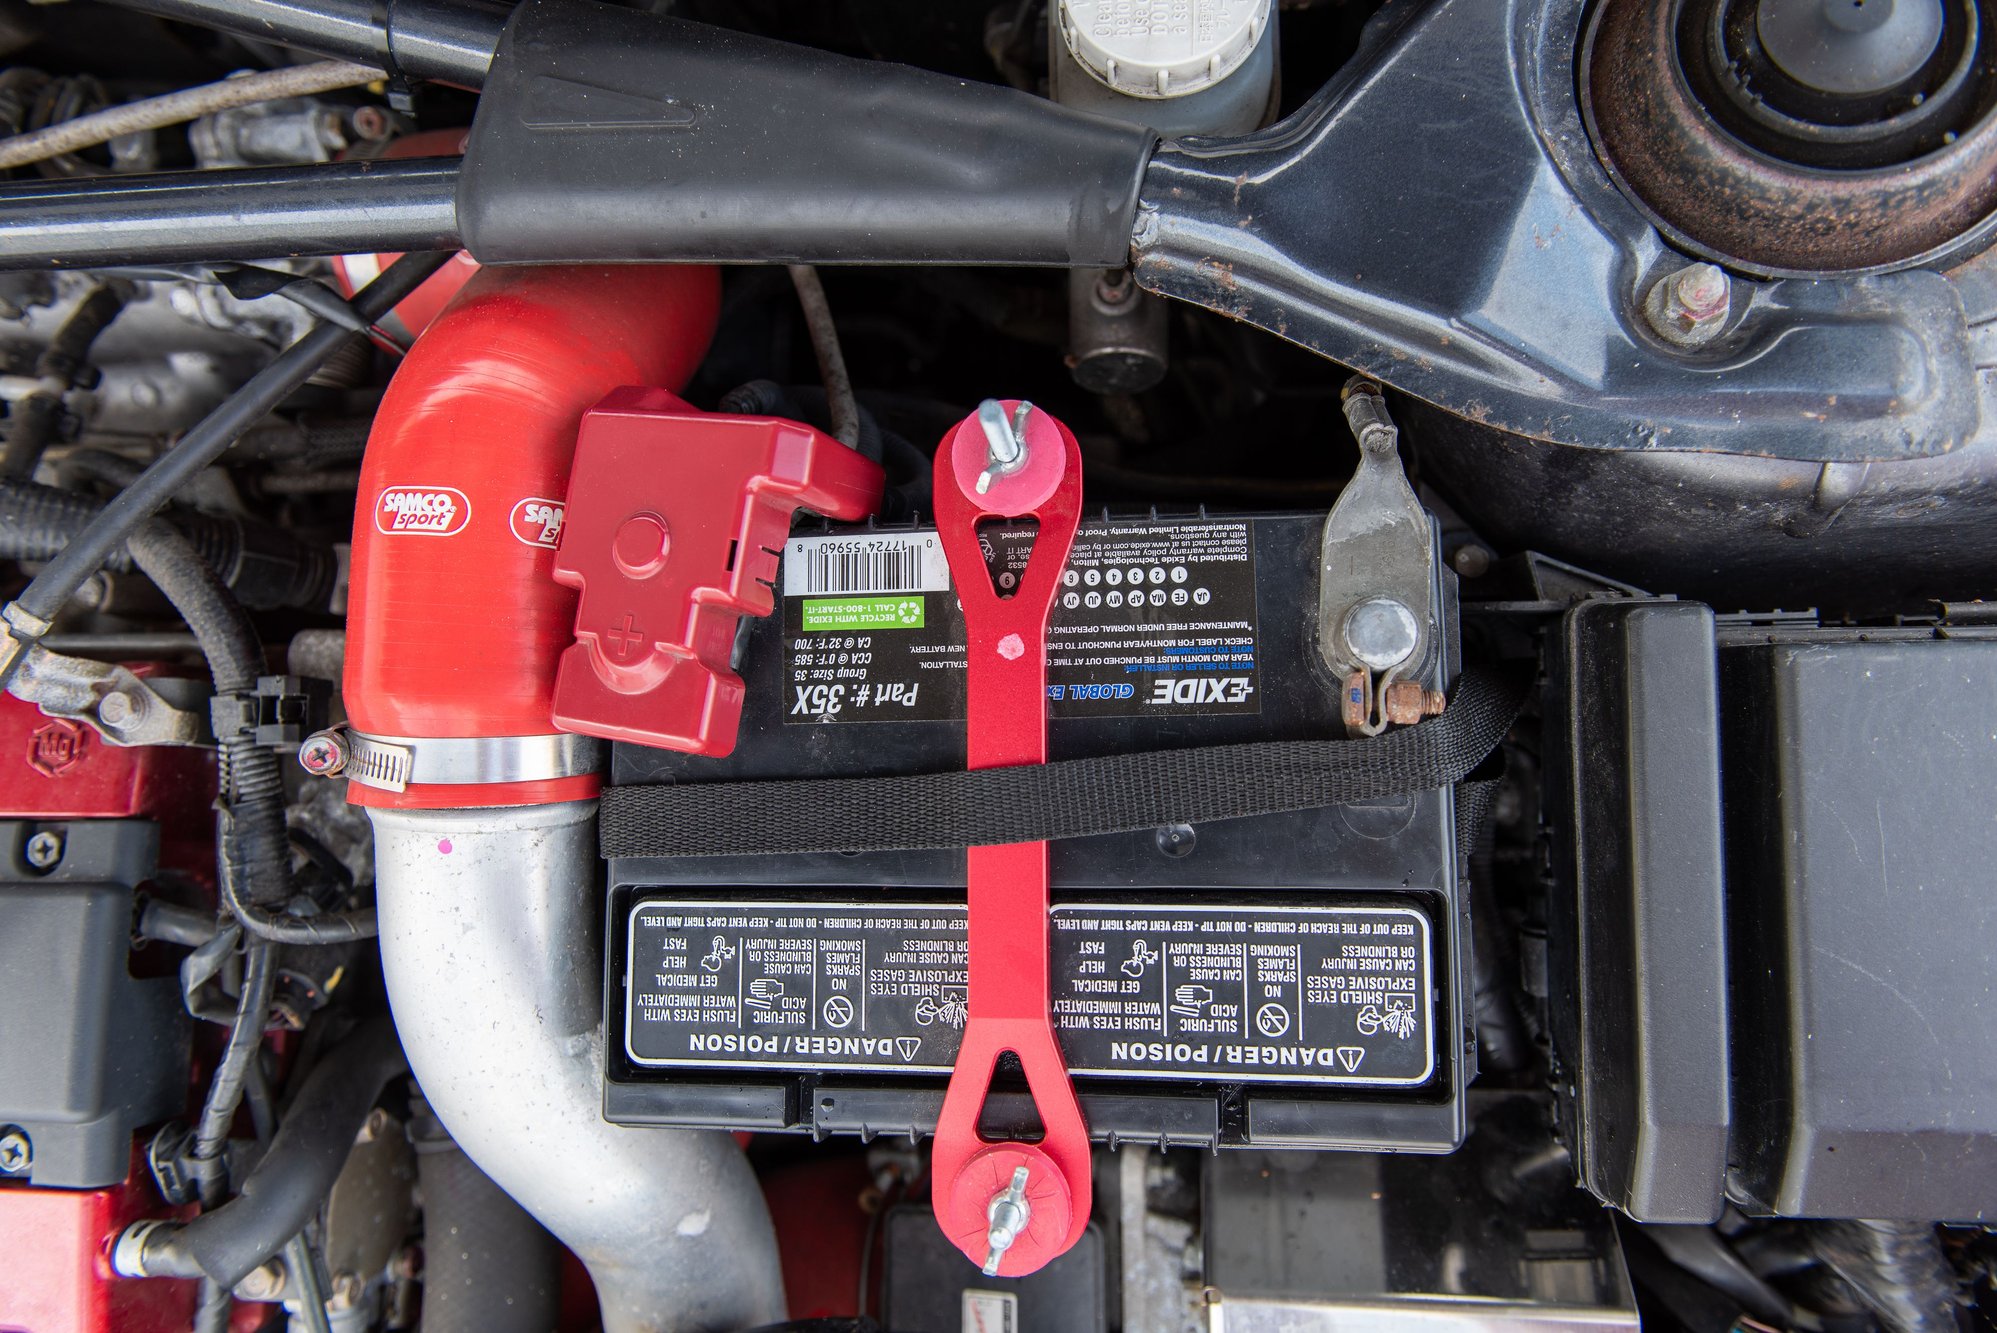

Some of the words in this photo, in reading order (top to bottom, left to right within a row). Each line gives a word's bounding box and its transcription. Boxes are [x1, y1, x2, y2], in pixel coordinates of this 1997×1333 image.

[1200, 0, 1213, 42] 日本国内
[384, 493, 452, 512] SAMCO
[398, 512, 445, 528] sport
[524, 504, 565, 526] SAM
[1000, 531, 1035, 539] required.
[798, 544, 802, 552] 8
[821, 542, 860, 554] 55960
[868, 541, 907, 552] 17724
[1101, 556, 1159, 565] Technologies,
[1162, 556, 1185, 564] Exide
[1201, 554, 1247, 562] Distributed
[1066, 597, 1076, 605] JY
[1088, 596, 1098, 605] JU
[1109, 596, 1121, 604] MY
[1131, 595, 1142, 603] AP
[1152, 594, 1164, 602] MA
[1175, 593, 1185, 601] FE
[1197, 592, 1207, 600] JA
[805, 605, 871, 614] 1-800-START-IT.
[875, 604, 895, 612] CALL
[807, 615, 832, 623] EXIDE.
[835, 615, 858, 623] WITH
[1054, 625, 1099, 633] OPERATING
[795, 639, 813, 649] 700
[844, 638, 855, 648] @
[858, 637, 871, 648] CA
[1124, 639, 1176, 648] MONTH/YEAR
[1196, 638, 1222, 646] LABEL
[1224, 637, 1253, 645] CHECK
[795, 655, 813, 665] 585
[838, 654, 848, 664] @
[852, 653, 871, 664] CCA
[1104, 656, 1142, 664] PUNCHED
[795, 670, 807, 680] 35
[810, 669, 834, 680] Size:
[837, 667, 866, 680] Group
[850, 684, 870, 706] #:
[874, 683, 919, 706] Part
[1047, 685, 1064, 700] Ex
[1069, 684, 1134, 699] GLOBAL
[1151, 677, 1253, 704] EXIDE
[791, 685, 844, 714] 35X
[1053, 919, 1080, 929] LEVEL.
[1082, 919, 1099, 930] AND
[1101, 919, 1123, 930] TIGHT
[1126, 920, 1147, 930] CAPS
[1149, 920, 1170, 930] VENT
[1172, 920, 1193, 931] KEEP
[1201, 921, 1214, 931] TIP
[1216, 921, 1232, 932] NOT
[1234, 921, 1246, 932] DO
[1254, 922, 1296, 933] CHILDREN
[1298, 923, 1308, 933] OF
[1311, 923, 1339, 934] REACH
[1342, 923, 1357, 934] THE
[1360, 924, 1370, 934] OF
[1373, 924, 1389, 935] OUT
[1391, 924, 1414, 935] KEEP
[663, 938, 686, 949] FAST
[745, 939, 776, 949] INJURY
[779, 939, 812, 950] SEVERE
[820, 940, 861, 951] SMOKING
[903, 940, 954, 951] BLINDNESS
[1079, 942, 1104, 954] FAST
[1169, 942, 1203, 954] INJURY
[1205, 943, 1242, 955] SEVERE
[750, 951, 761, 961] OR
[1250, 945, 1296, 956] SMOKING
[1342, 945, 1397, 957] BLINDNESS
[1401, 946, 1415, 957] OR
[663, 956, 686, 968] HELP
[764, 951, 811, 962] BLINDNESS
[826, 953, 860, 963] FLAMES
[884, 952, 916, 962] INJURY
[919, 952, 949, 963] CAUSE
[1174, 955, 1186, 967] OR
[1189, 956, 1242, 968] BLINDNESS
[764, 963, 792, 974] CAUSE
[795, 964, 811, 974] CAN
[1079, 960, 1105, 973] HELP
[1257, 958, 1295, 969] FLAMES
[1321, 958, 1357, 969] INJURY
[1360, 959, 1392, 970] CAUSE
[1395, 959, 1415, 970] CAN
[826, 965, 861, 975] SPARKS
[870, 970, 905, 981] GASES
[1190, 968, 1220, 980] CAUSE
[1224, 969, 1242, 980] CAN
[656, 974, 697, 986] MEDICAL
[700, 975, 717, 987] GET
[909, 970, 968, 982] EXPLOSIVE
[1258, 971, 1296, 982] SPARKS
[832, 978, 846, 990] NO
[1072, 980, 1117, 992] MEDICAL
[1120, 981, 1140, 993] GET
[1307, 976, 1345, 988] GASES
[1348, 976, 1415, 989] EXPLOSIVE
[870, 983, 896, 995] EYES
[901, 984, 939, 995] SHIELD
[1264, 985, 1281, 997] NO
[637, 994, 700, 1006] IMMEDIATELY
[704, 995, 736, 1007] WATER
[1308, 991, 1337, 1003] EYES
[1341, 991, 1383, 1004] SHIELD
[782, 997, 806, 1009] ACID
[1053, 1000, 1121, 1013] IMMEDIATELY
[1124, 1002, 1161, 1015] WATER
[644, 1009, 671, 1021] WITH
[674, 1009, 699, 1021] EYES
[703, 1010, 736, 1022] FLUSH
[1211, 1004, 1238, 1017] ACID
[753, 1011, 805, 1023] SULFURIC
[1061, 1016, 1089, 1028] WITH
[1093, 1016, 1121, 1029] EYES
[1125, 1017, 1161, 1030] FLUSH
[1180, 1019, 1237, 1032] SULFURIC
[690, 1034, 777, 1052] POISON
[794, 1036, 892, 1056] DANGER
[1111, 1042, 1207, 1062] POISON
[1226, 1046, 1334, 1066] DANGER
